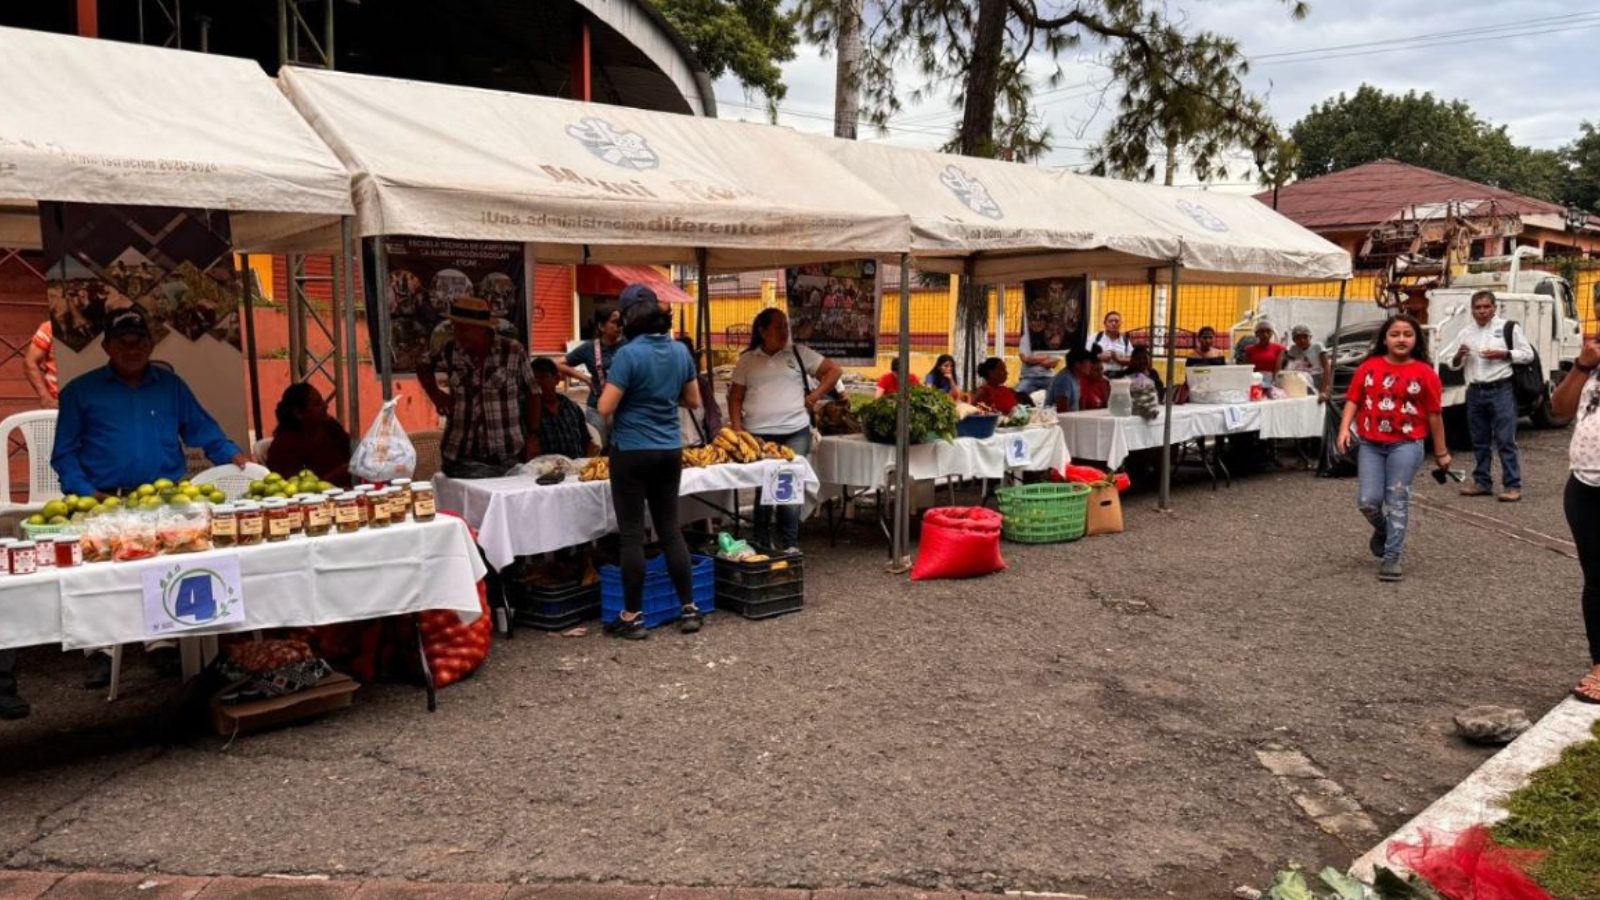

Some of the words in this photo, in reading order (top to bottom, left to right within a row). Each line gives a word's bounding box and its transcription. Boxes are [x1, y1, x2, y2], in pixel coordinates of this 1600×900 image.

[647, 216, 763, 236] diferente
[1014, 439, 1024, 458] 2
[775, 473, 793, 500] 3
[174, 573, 217, 620] 4
